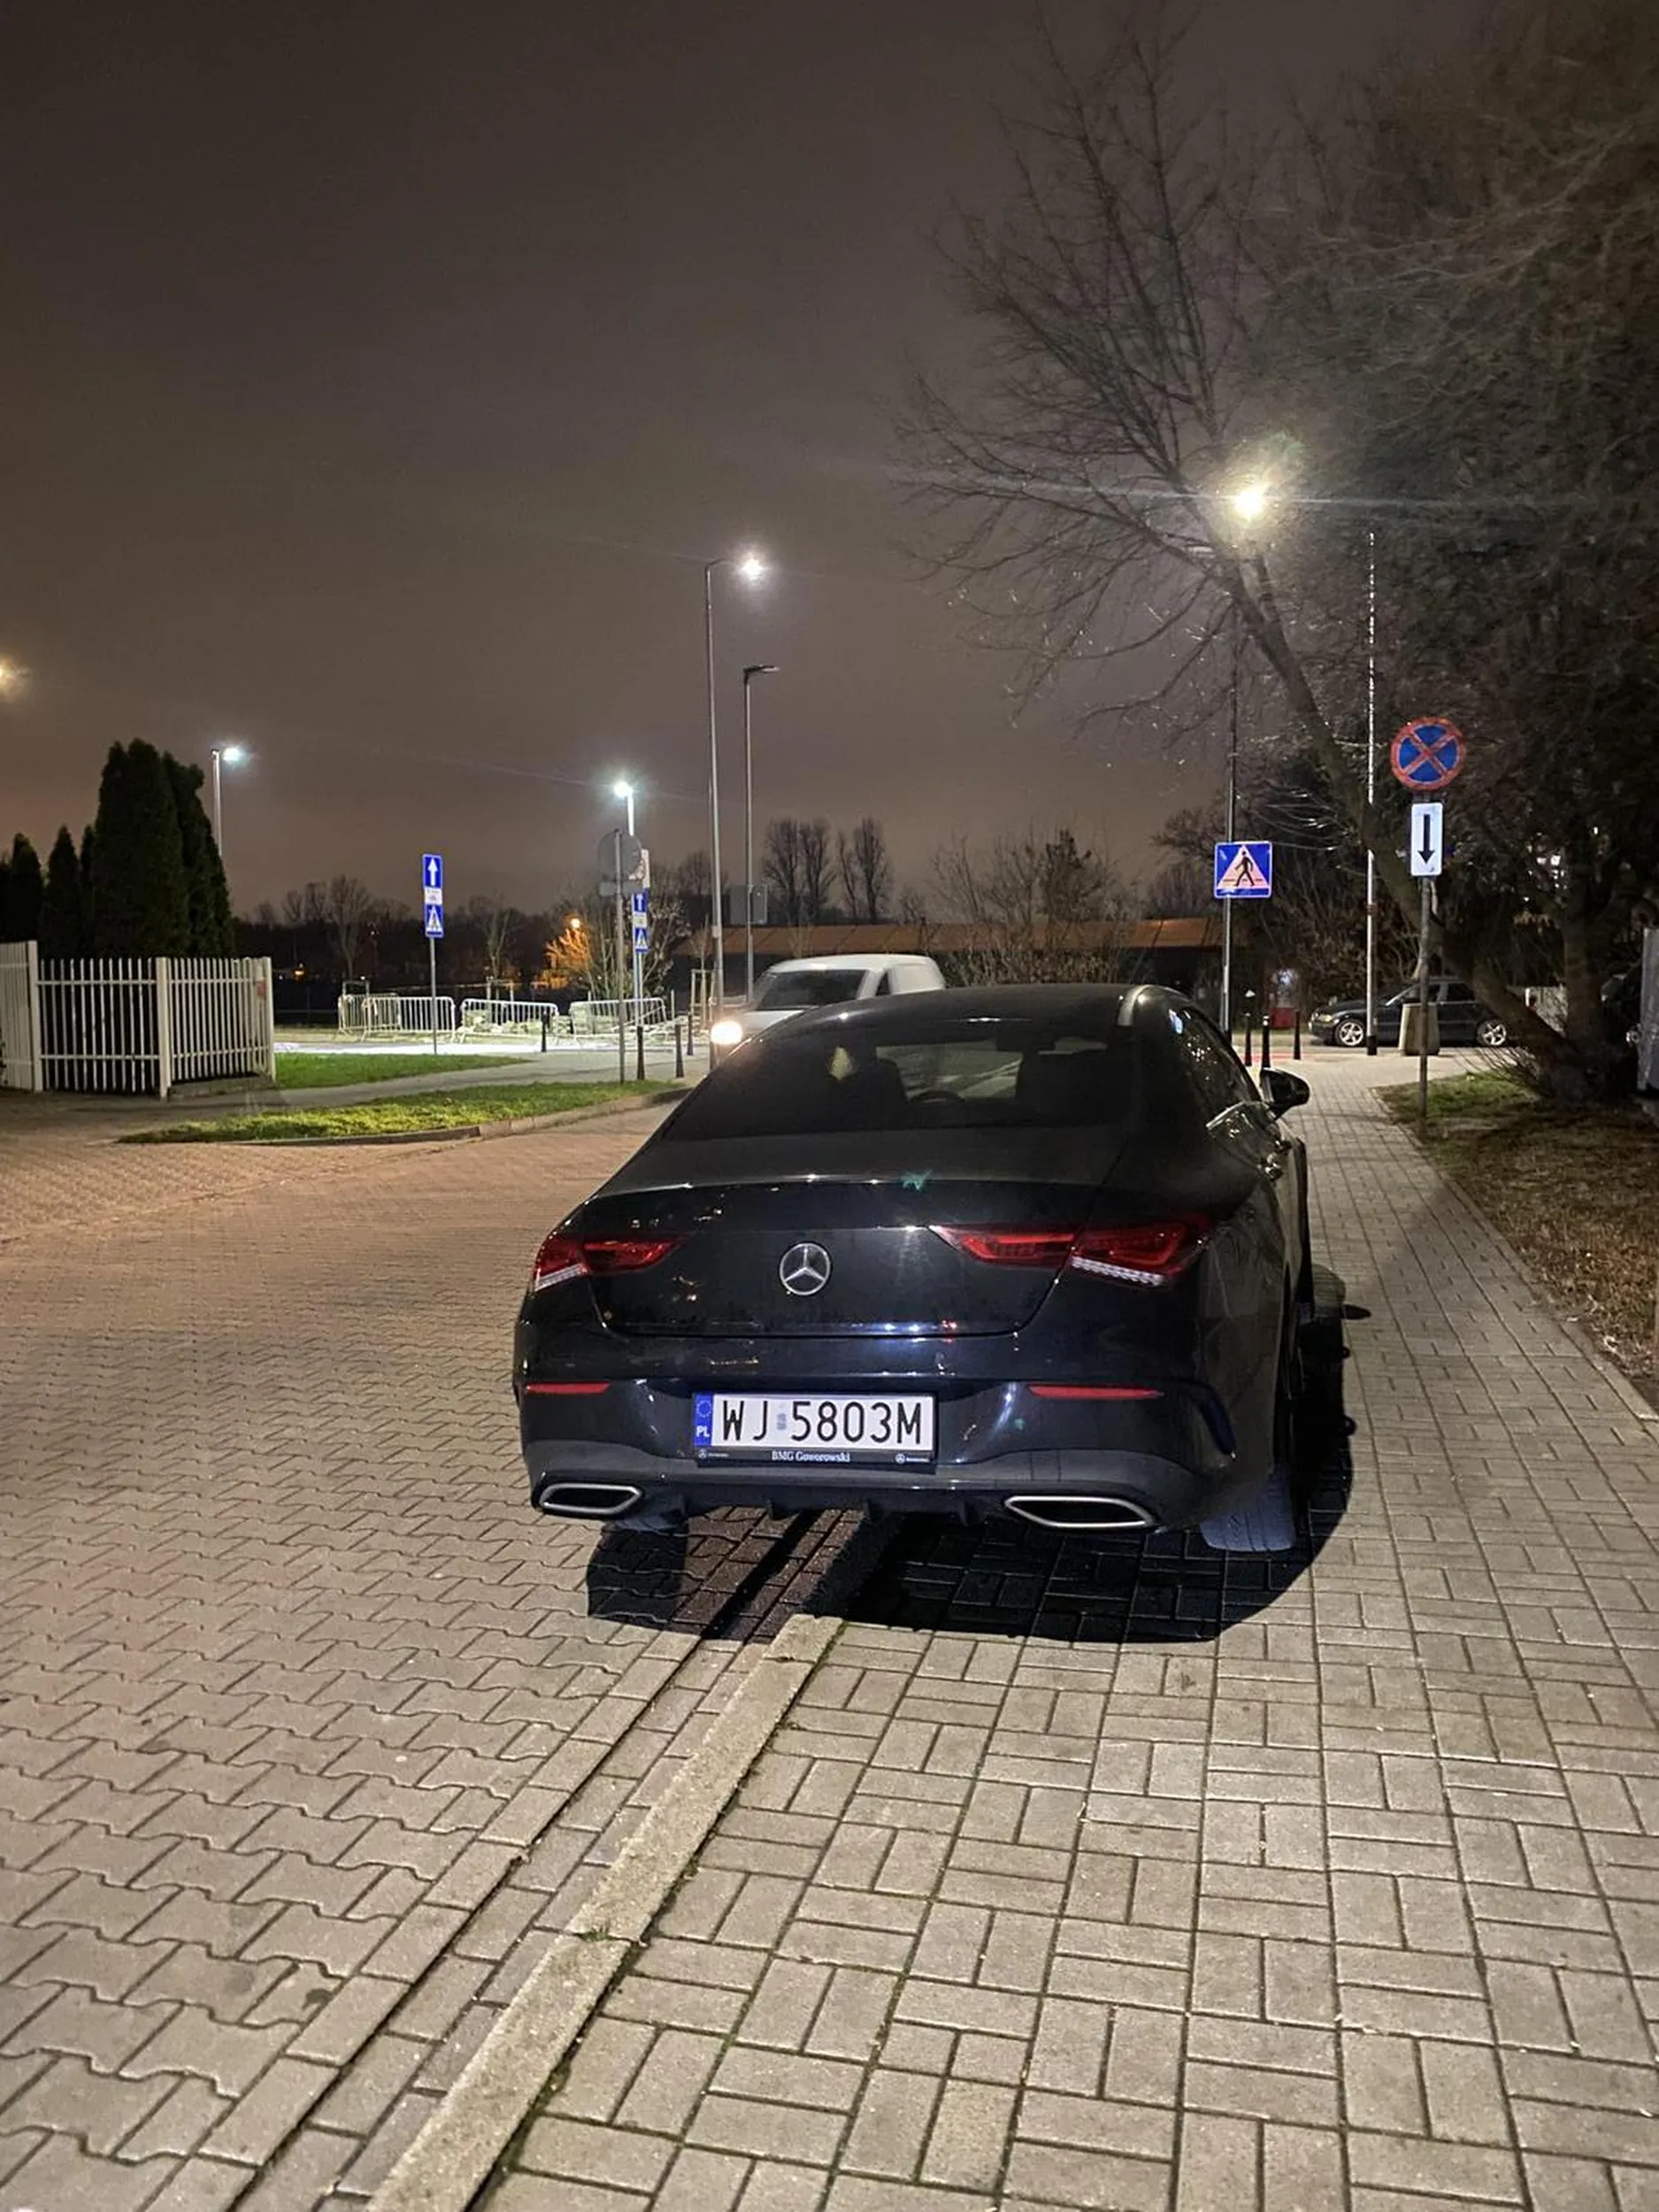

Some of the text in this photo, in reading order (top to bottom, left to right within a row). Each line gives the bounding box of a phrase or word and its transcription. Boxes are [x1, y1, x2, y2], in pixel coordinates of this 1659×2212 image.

[695, 1425, 710, 1437] PL
[723, 1401, 921, 1444] WJ 5803M
